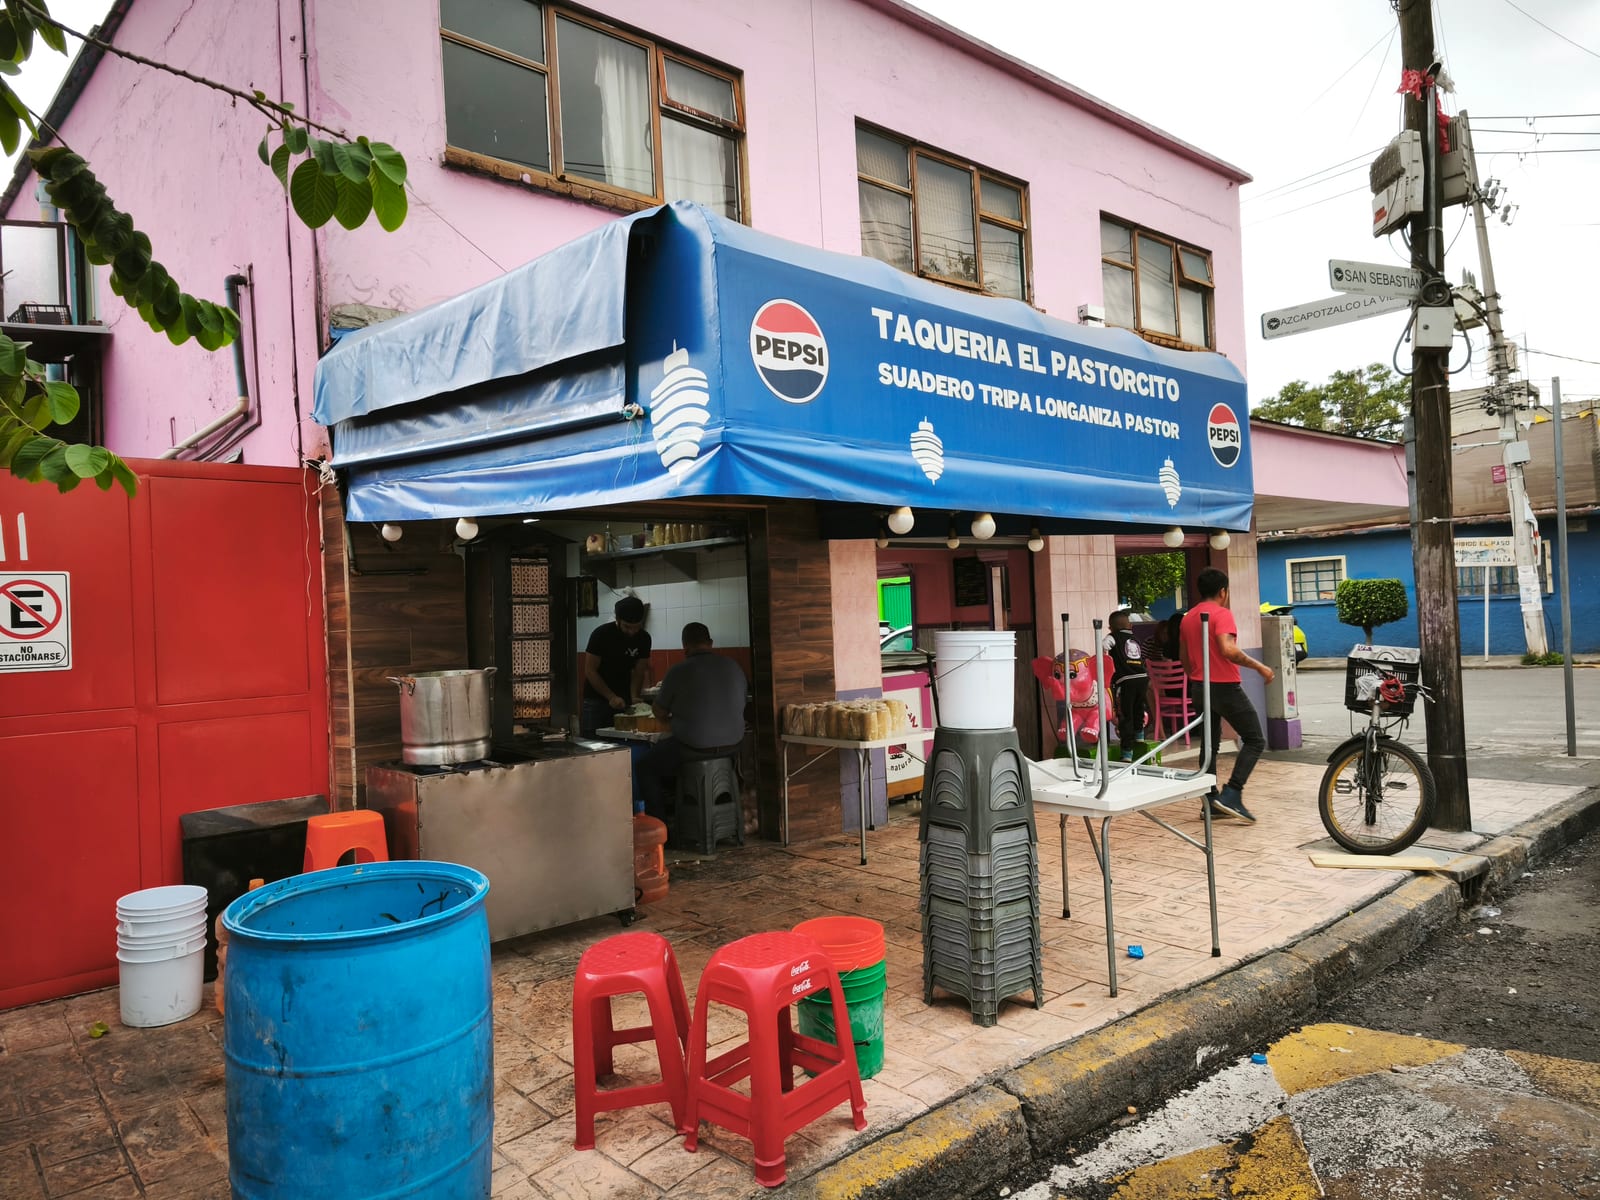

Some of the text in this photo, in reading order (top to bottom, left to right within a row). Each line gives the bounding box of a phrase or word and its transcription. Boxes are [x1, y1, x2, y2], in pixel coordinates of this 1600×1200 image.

[1344, 269, 1367, 283] SAN
[1280, 302, 1361, 326] AZCAPOTZALCO
[1363, 297, 1377, 307] LA
[755, 334, 824, 366] PEPSI
[871, 307, 1180, 402] TAQUERIA EL PASTORCITO
[878, 362, 1180, 440] SUADERO TRIPA LONGANIZA PASTOR
[1209, 427, 1239, 443] PEPSI
[20, 645, 33, 654] NO
[890, 757, 913, 772] natura
